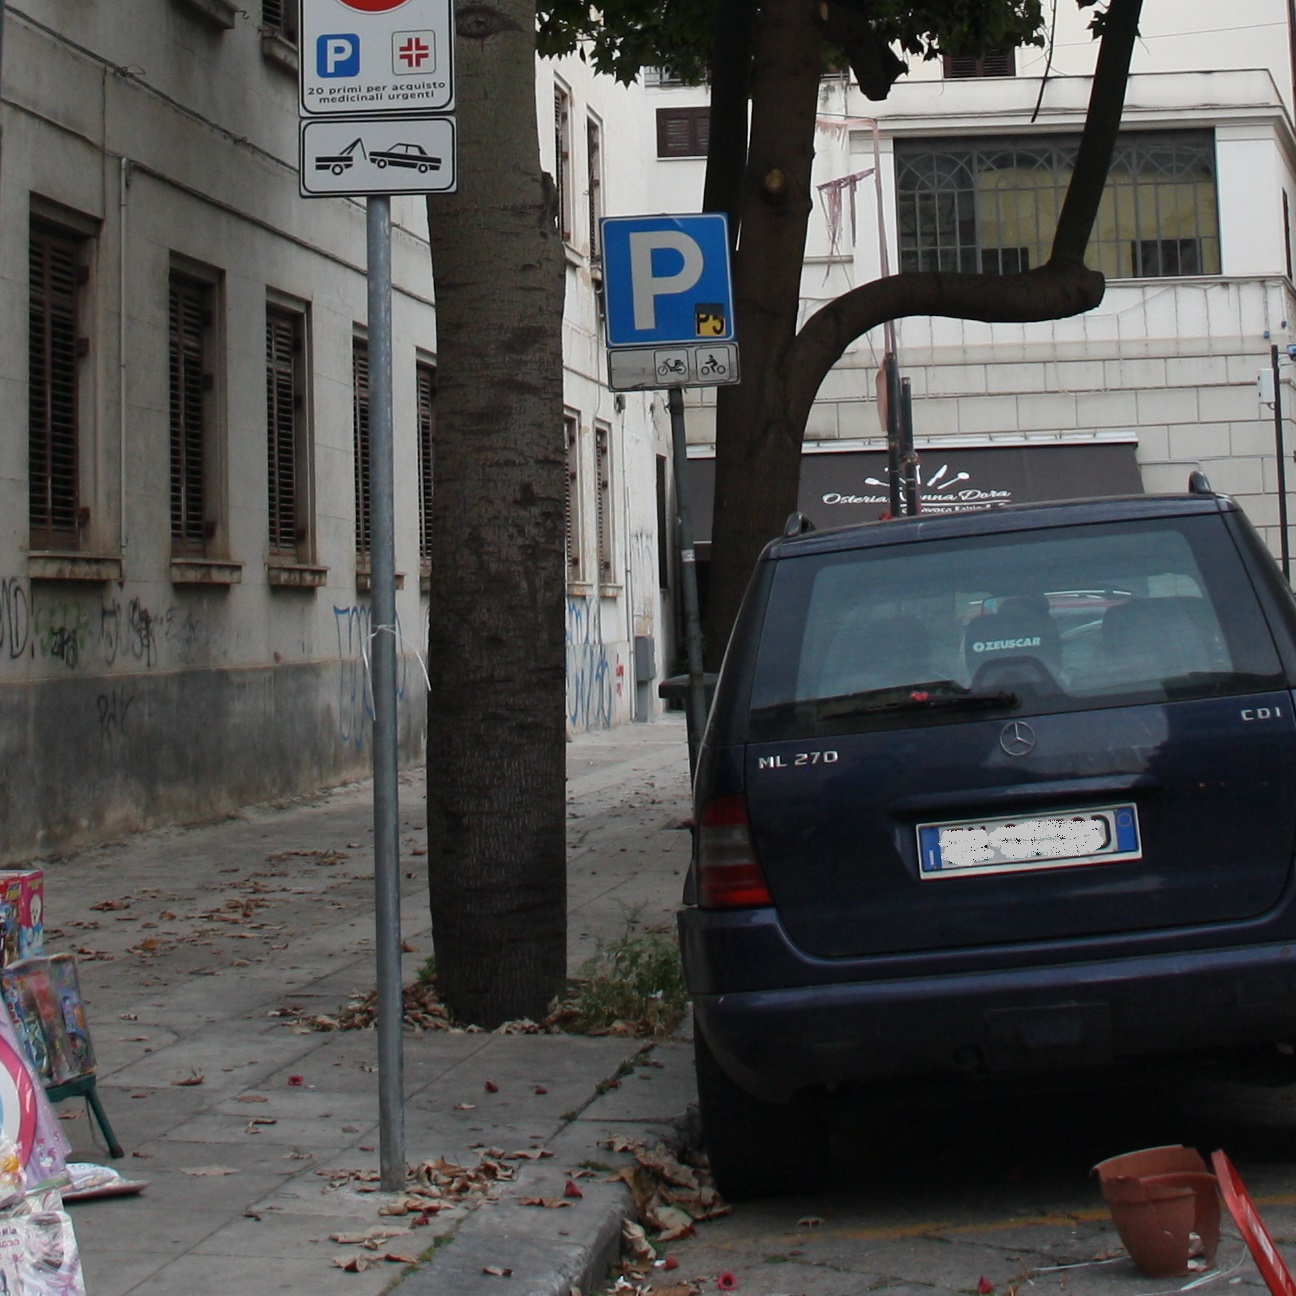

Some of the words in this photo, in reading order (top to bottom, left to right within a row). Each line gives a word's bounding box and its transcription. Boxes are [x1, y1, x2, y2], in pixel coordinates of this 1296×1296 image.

[326, 38, 353, 74] P
[308, 87, 324, 96] 20
[329, 84, 362, 96] primi
[366, 85, 387, 94] per
[391, 81, 446, 92] acquisto
[319, 93, 383, 104] medicinali
[388, 90, 435, 102] urgenti
[629, 229, 704, 331] P
[821, 491, 888, 505] Osteria
[984, 636, 1042, 653] ZEUSCAR
[1240, 708, 1283, 723] CDI
[759, 755, 788, 770] ML
[794, 750, 840, 767] 270
